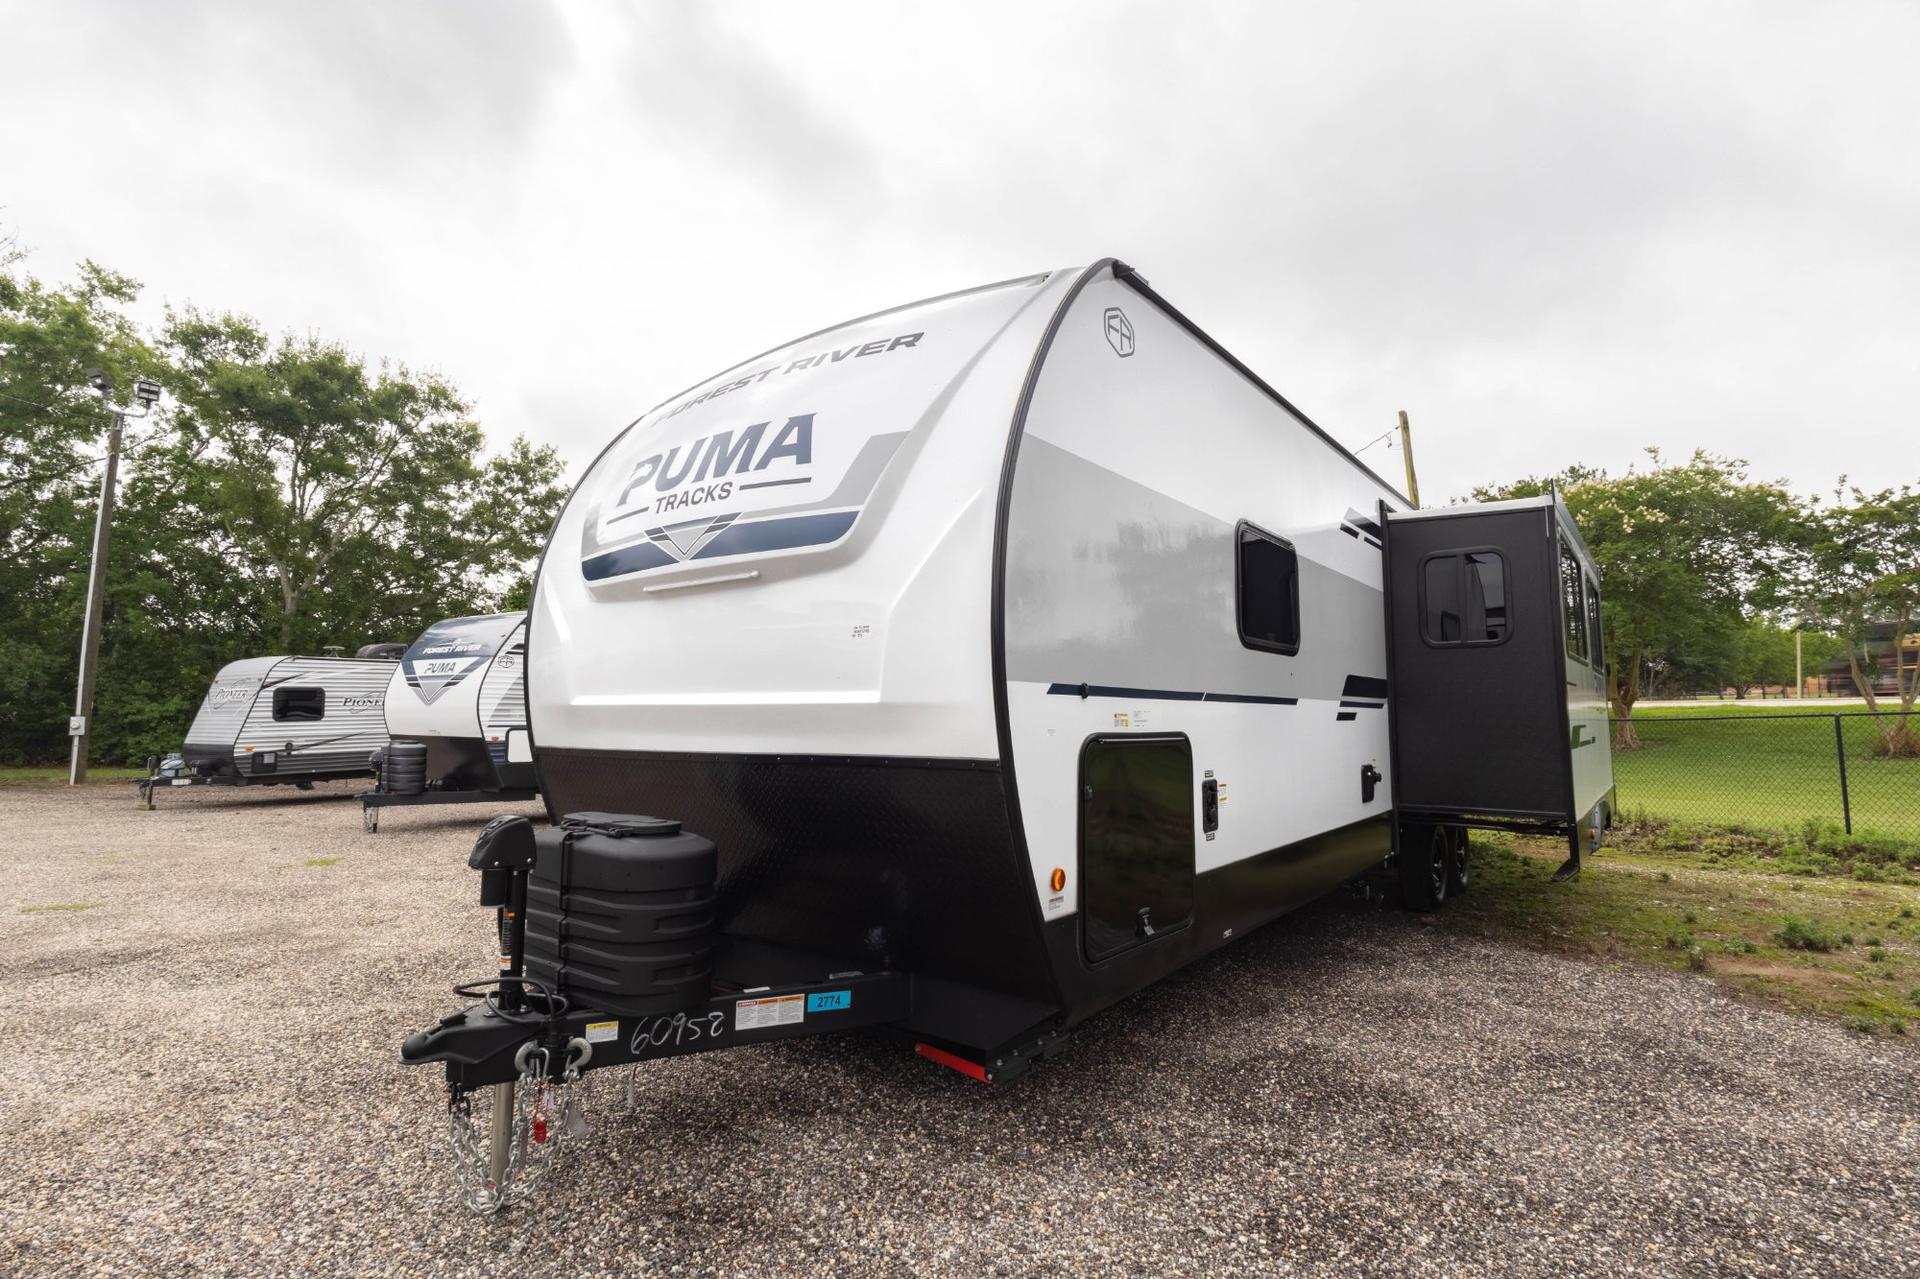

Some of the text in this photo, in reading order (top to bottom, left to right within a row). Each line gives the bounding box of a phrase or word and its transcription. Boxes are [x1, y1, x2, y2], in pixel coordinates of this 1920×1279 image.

[650, 332, 924, 428] FOREST RIVER
[616, 412, 817, 508] PUMA
[655, 481, 733, 514] TRACKS
[424, 662, 456, 674] PUMA
[343, 697, 384, 706] PIONE
[817, 995, 841, 1008] 2774
